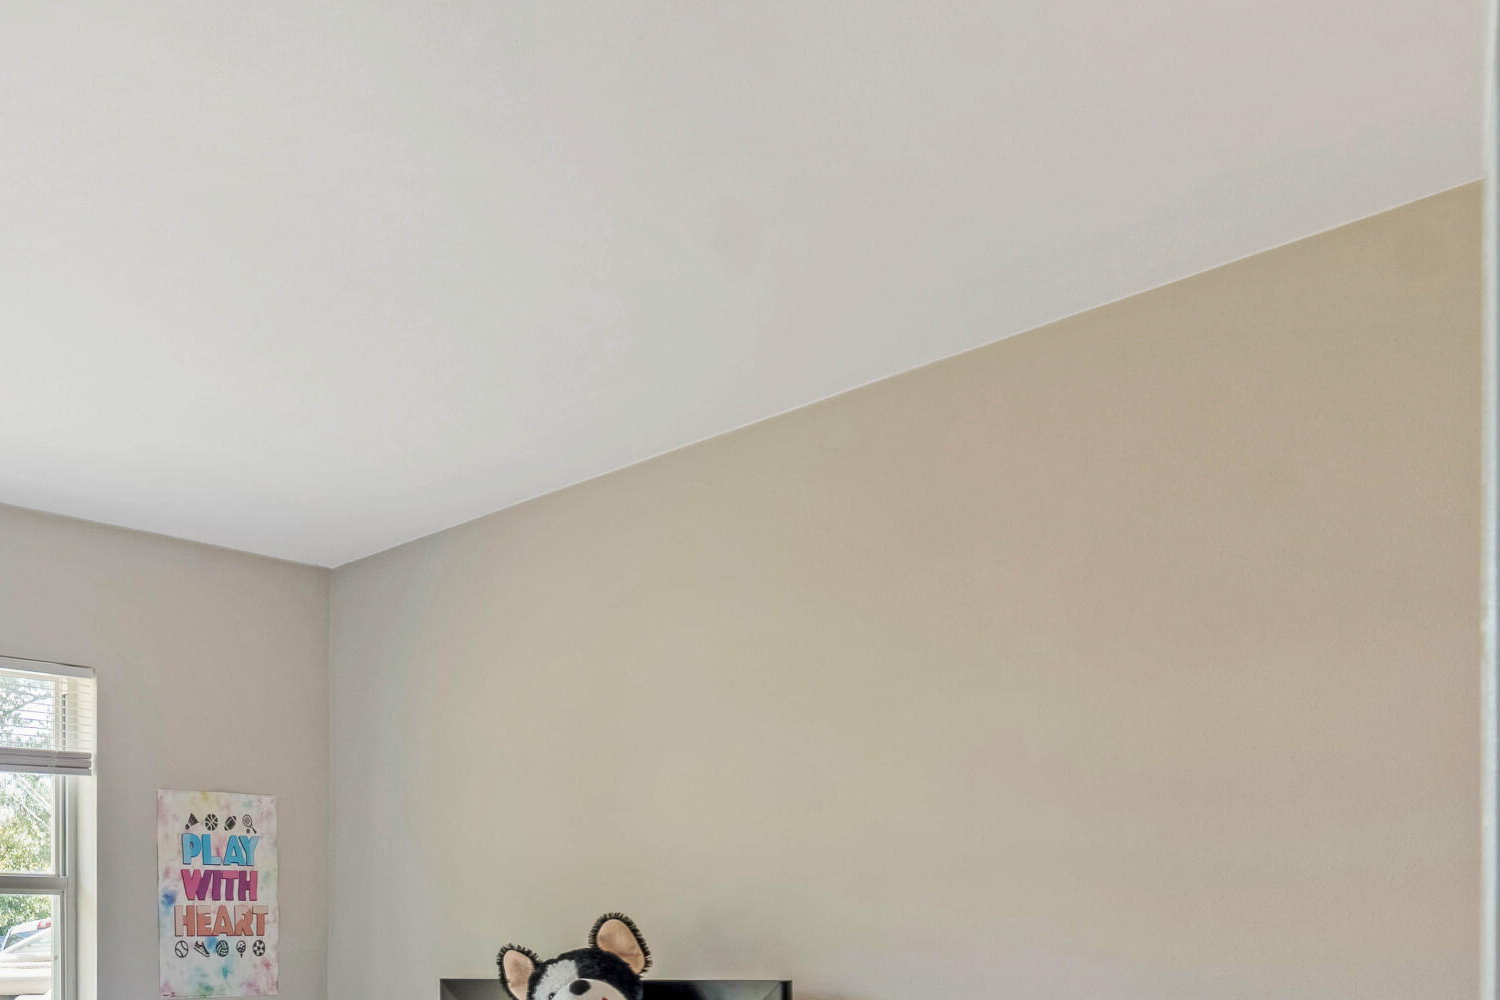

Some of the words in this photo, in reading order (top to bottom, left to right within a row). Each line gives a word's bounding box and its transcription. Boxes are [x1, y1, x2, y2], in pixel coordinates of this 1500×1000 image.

[181, 833, 260, 866] PLAY
[181, 869, 258, 901] WITH
[174, 905, 269, 937] HEART
